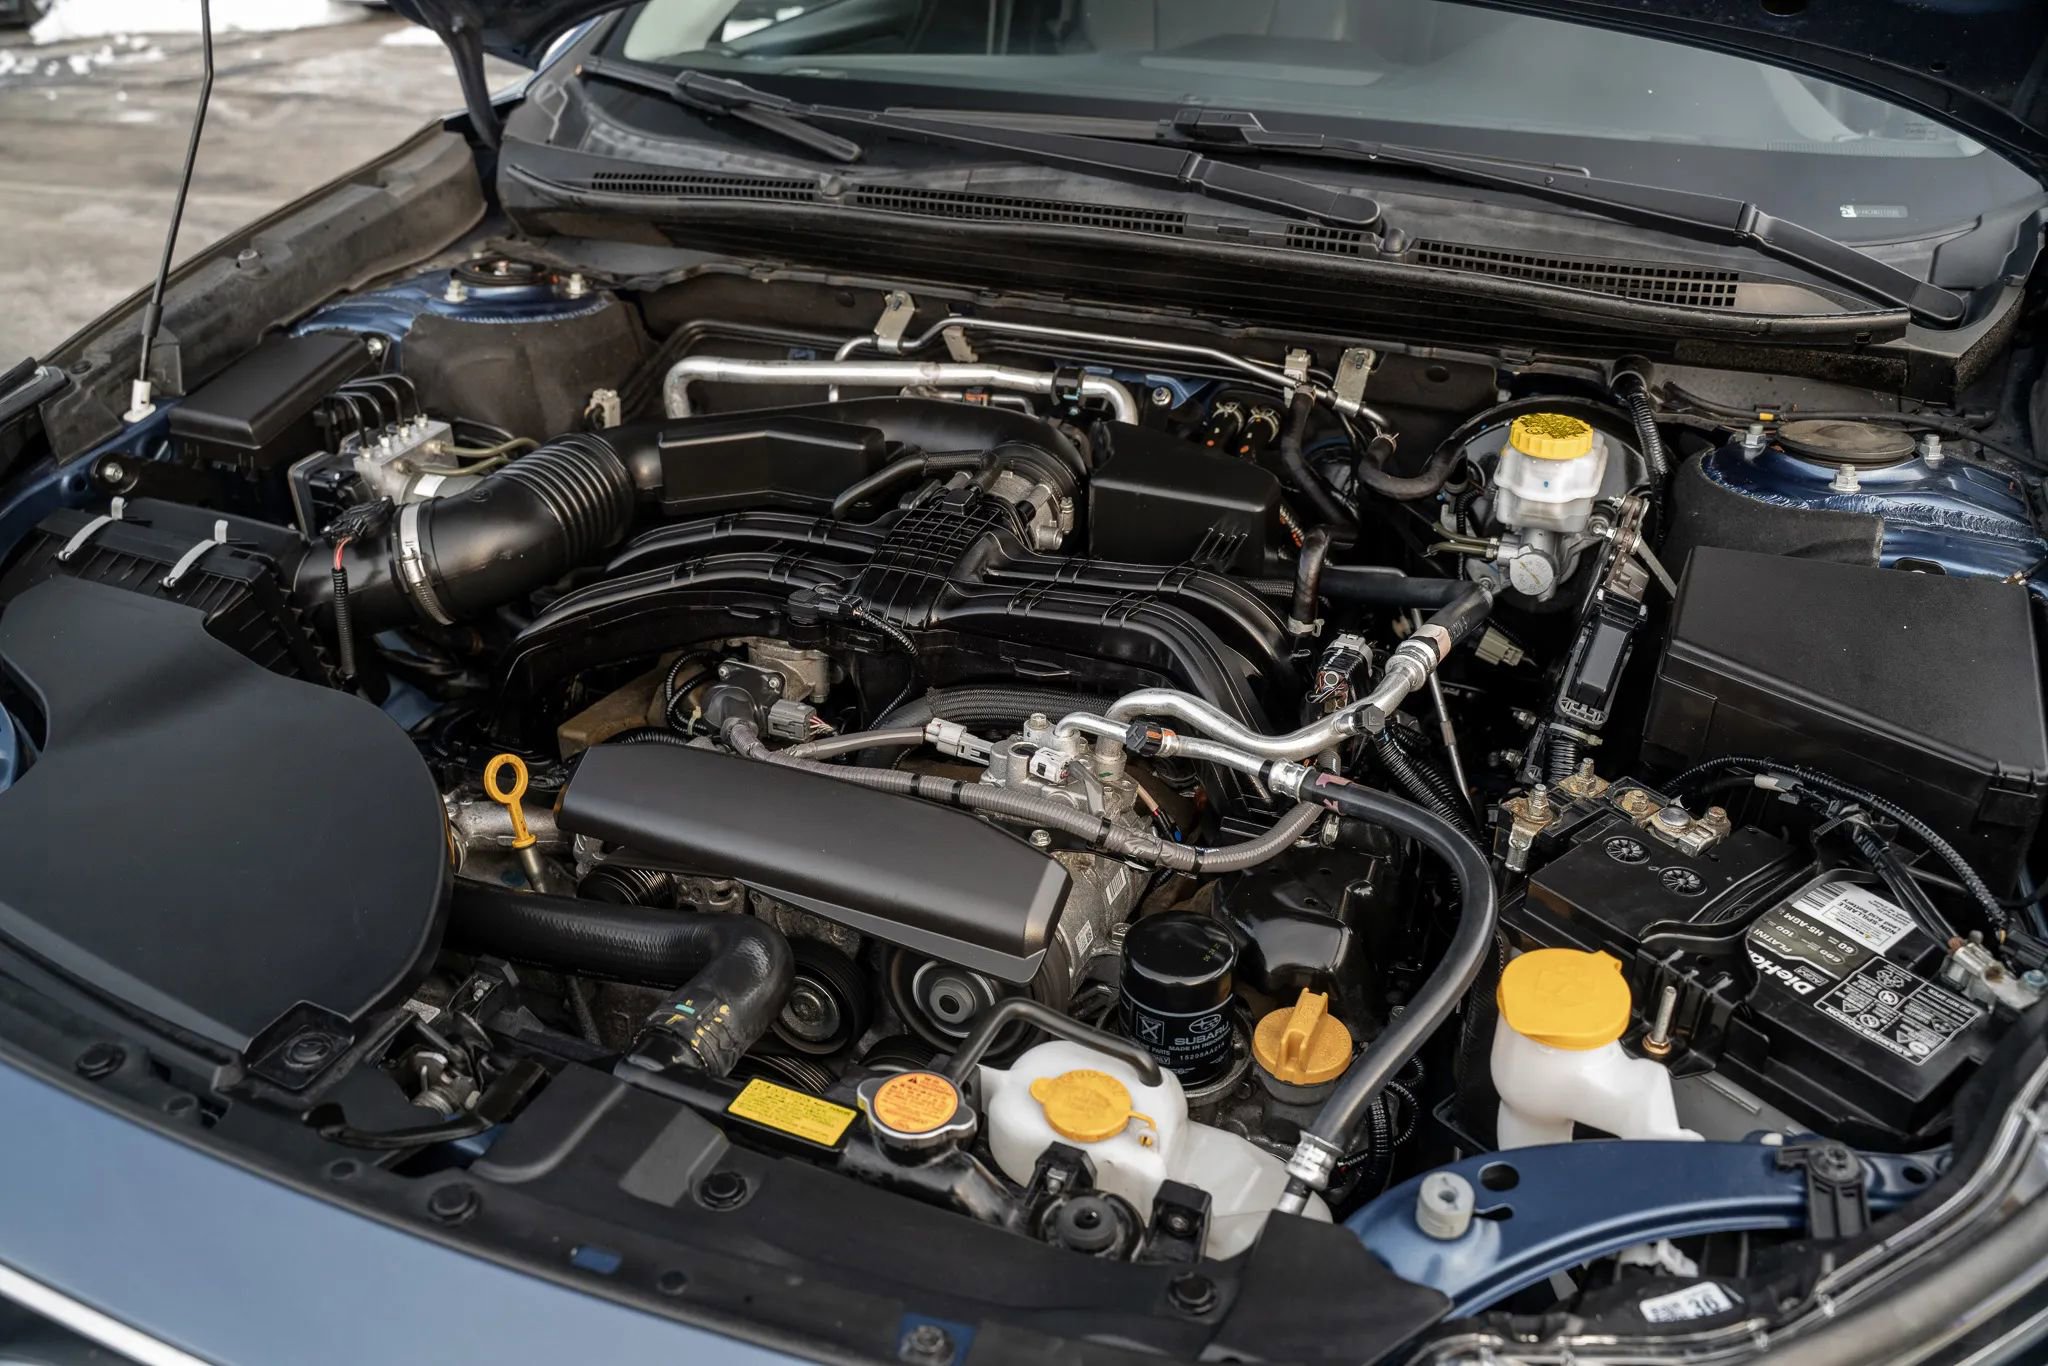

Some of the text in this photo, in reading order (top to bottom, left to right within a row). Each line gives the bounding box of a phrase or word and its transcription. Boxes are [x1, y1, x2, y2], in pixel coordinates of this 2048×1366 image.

[1841, 897, 1869, 914] Battery
[1783, 912, 1824, 937] H5-AGM
[1836, 900, 1896, 936] NON-SPILLABLE
[1867, 912, 1883, 922] Acid
[1839, 942, 1854, 955] 60
[1174, 1021, 1230, 1046] SUBARU
